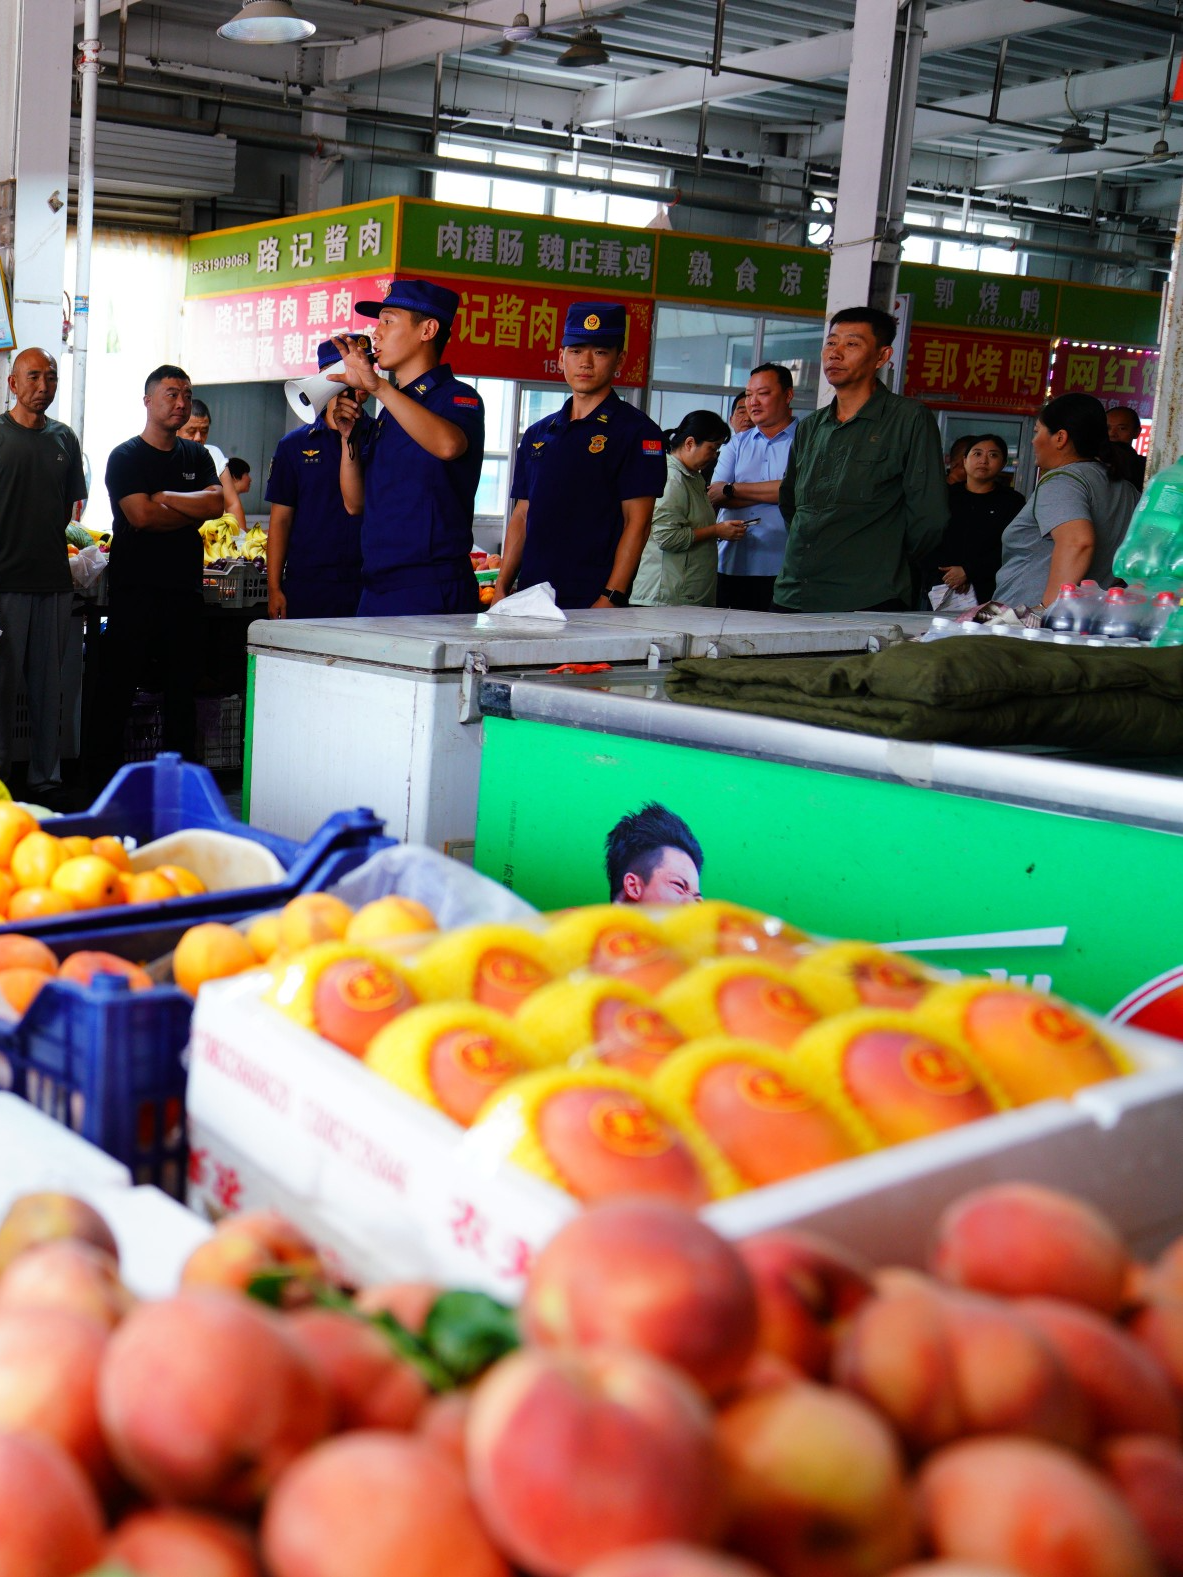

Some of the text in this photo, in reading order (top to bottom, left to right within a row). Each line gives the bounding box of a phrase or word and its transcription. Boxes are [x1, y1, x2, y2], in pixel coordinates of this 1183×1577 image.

[191, 252, 250, 275] 15531909068
[256, 218, 382, 273] 路记酱肉
[436, 219, 652, 281] 肉灌肠 魏庄熏鸡
[687, 248, 830, 300] 熟食凉
[934, 277, 1041, 320] 郭烤鸭
[214, 287, 353, 335] 路记酱肉 熏肉
